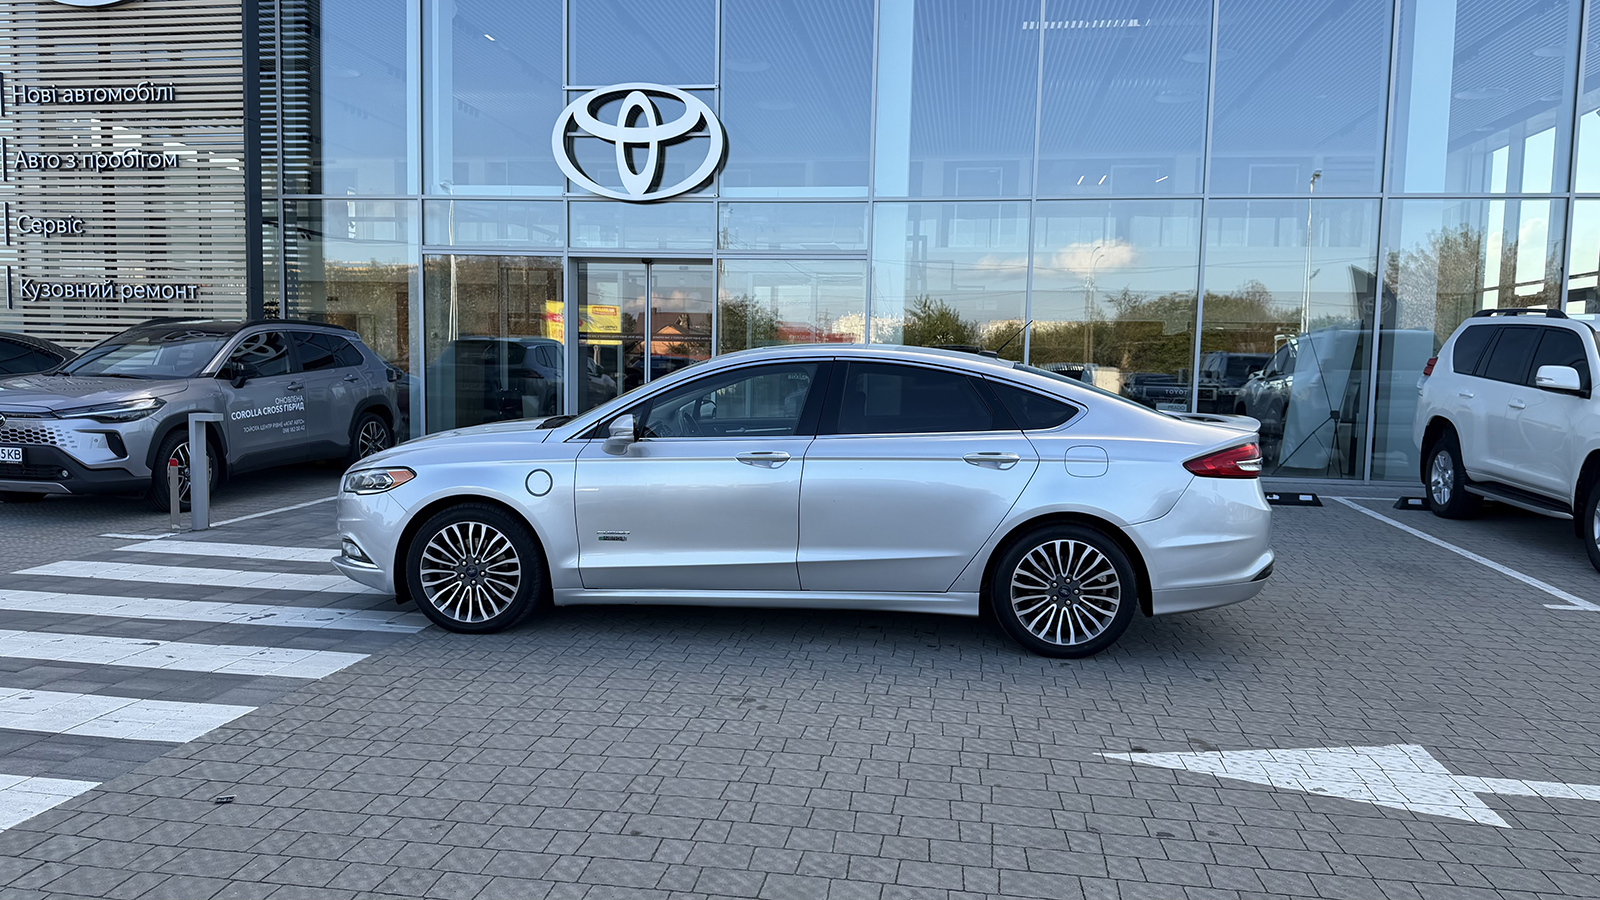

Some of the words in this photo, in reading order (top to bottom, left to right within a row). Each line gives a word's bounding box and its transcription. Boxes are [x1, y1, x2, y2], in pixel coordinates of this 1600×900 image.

[12, 84, 58, 103] Нові
[63, 81, 175, 102] автомобілі
[14, 150, 61, 169] Авто
[66, 154, 78, 168] з
[83, 148, 179, 172] пробігом
[17, 215, 85, 238] Сервіс
[19, 279, 118, 301] Кузовний
[121, 284, 199, 303] ремонт
[231, 408, 262, 420] COROLLA
[262, 404, 283, 415] CROSS
